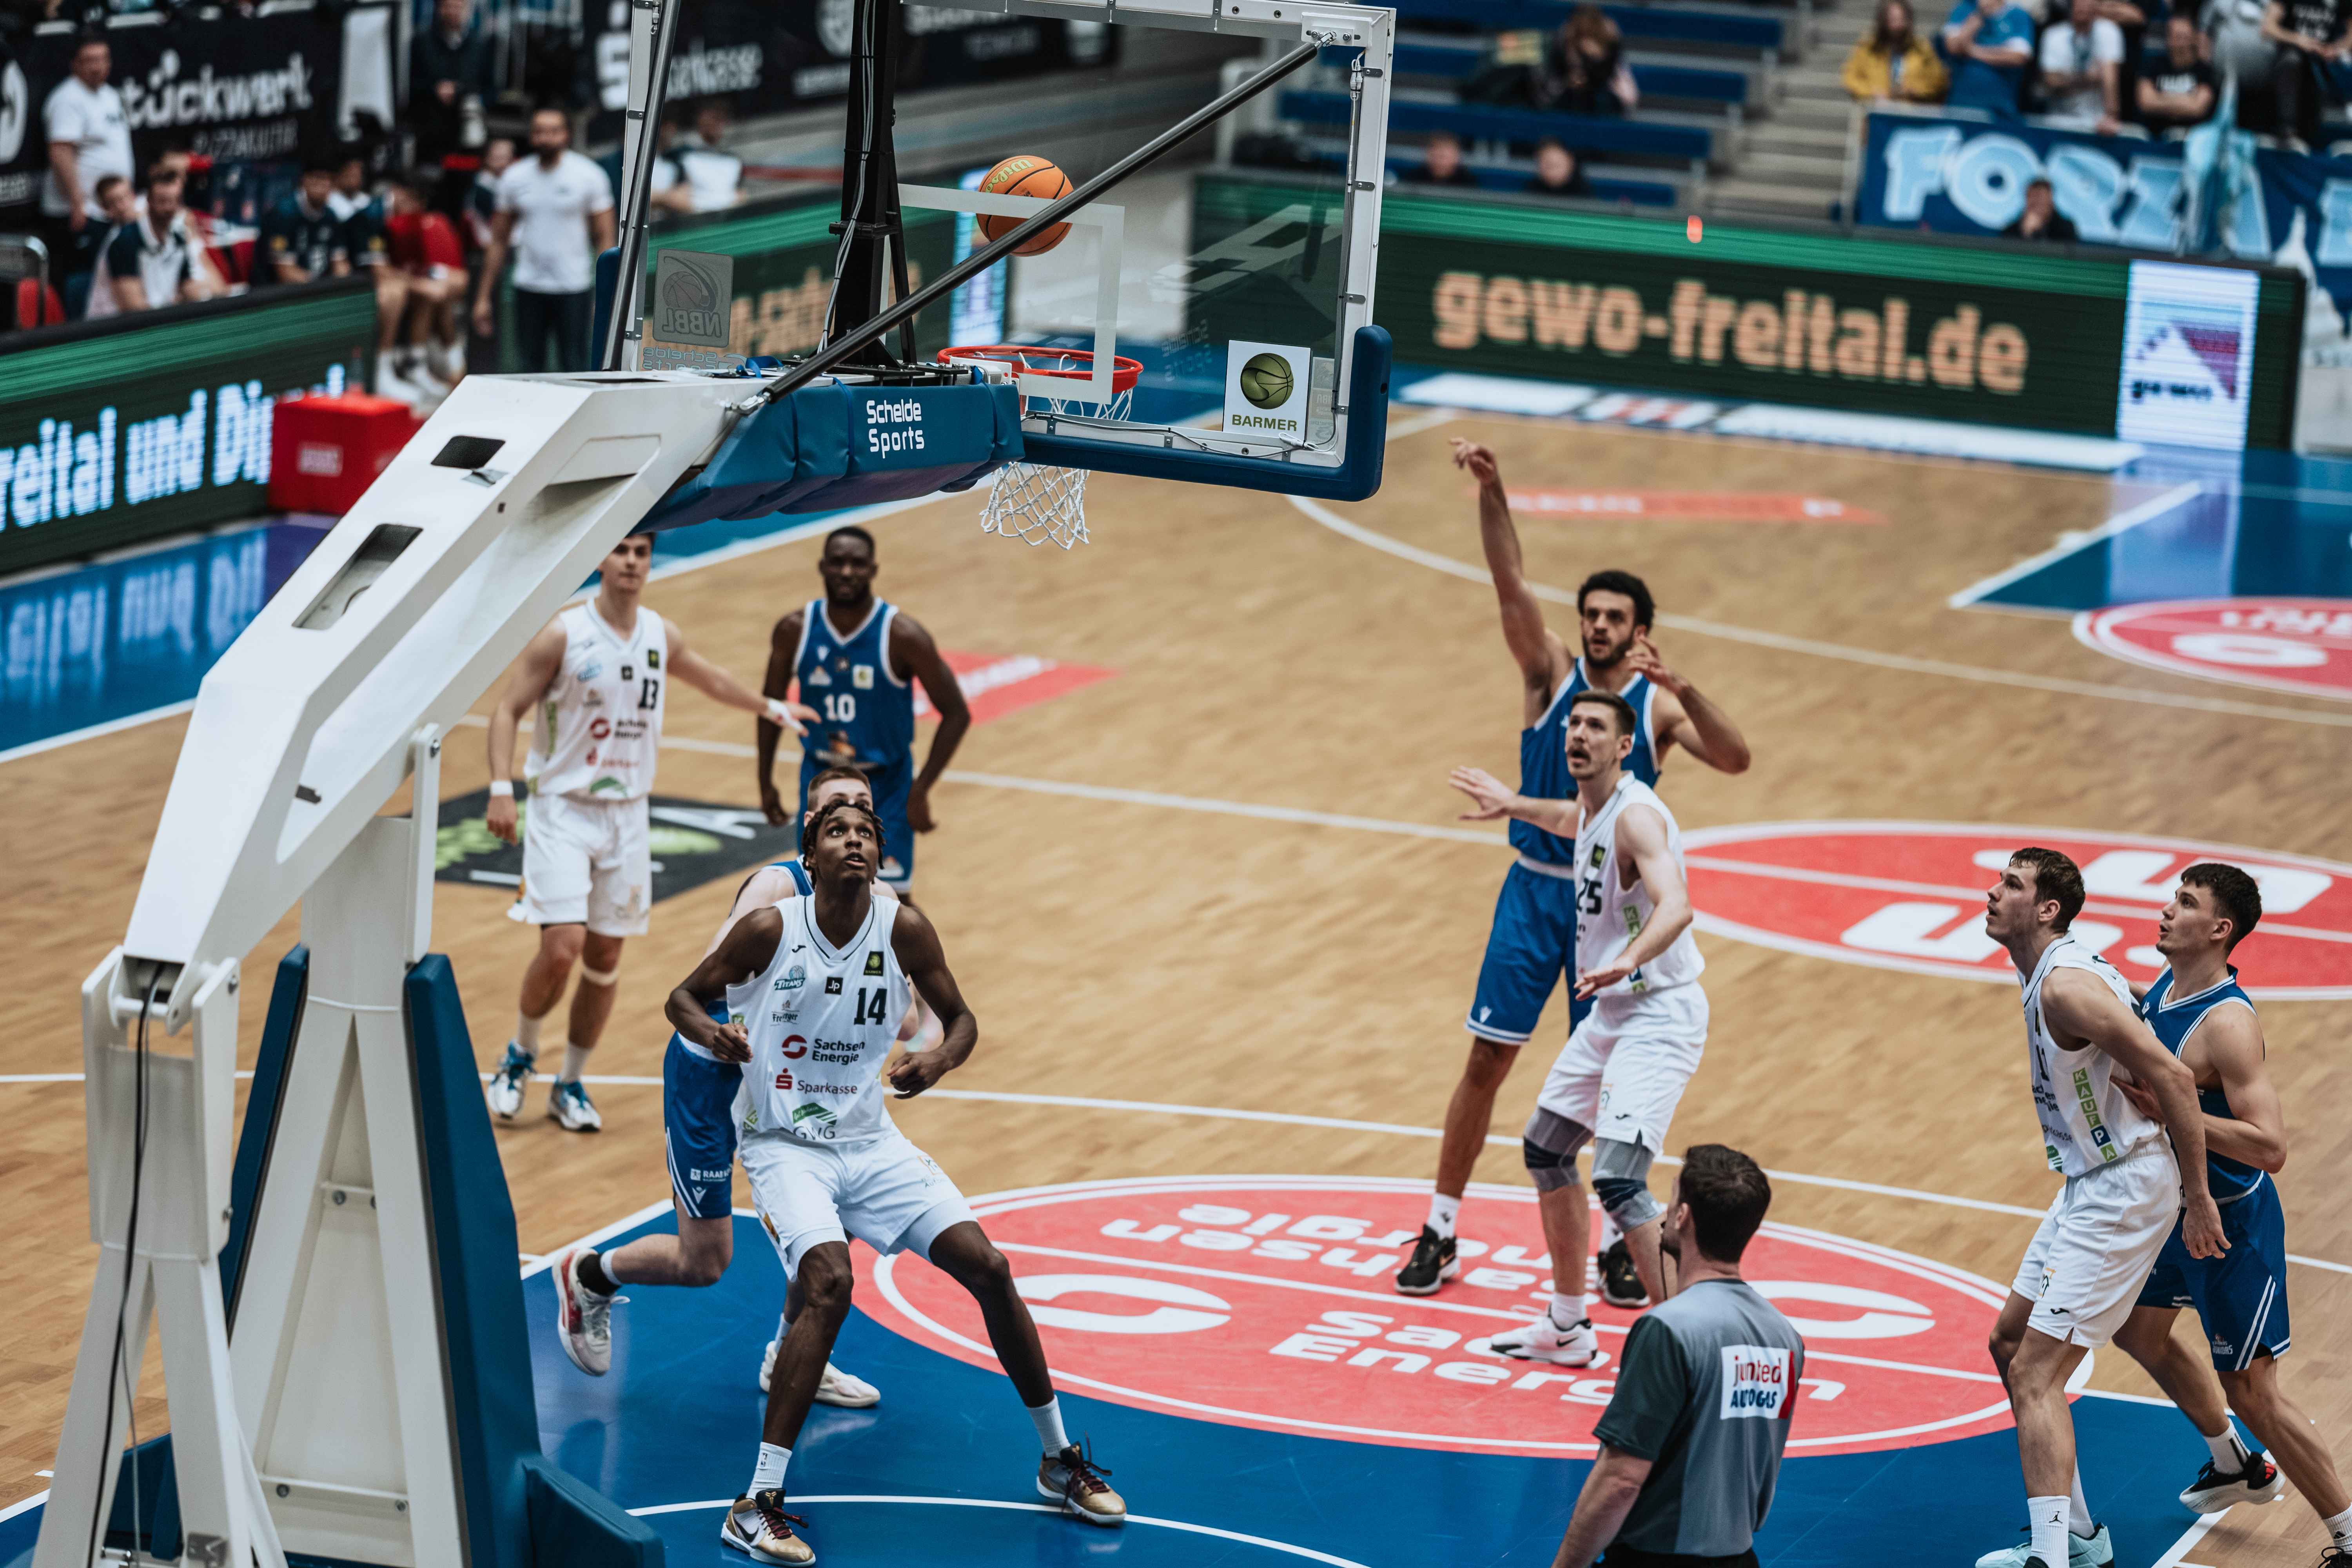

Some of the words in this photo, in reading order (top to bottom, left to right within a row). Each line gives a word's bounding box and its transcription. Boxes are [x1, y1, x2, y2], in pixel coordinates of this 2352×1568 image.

[122, 49, 314, 130] tückwerk
[985, 159, 1035, 193] Wilso
[1432, 270, 2030, 393] gewo-freital.de
[866, 398, 922, 424] Schelde
[1232, 414, 1297, 431] BARMER
[125, 388, 207, 505] und
[869, 426, 924, 459] Sports
[638, 678, 659, 710] 13
[824, 693, 856, 722] 10
[1576, 876, 1602, 915] 25
[854, 987, 887, 1025] 14
[812, 1050, 859, 1065] Energie
[813, 1038, 865, 1052] Sachsen
[797, 1080, 858, 1094] Sparkasse
[793, 1126, 835, 1140] GWG
[1269, 1332, 1614, 1407] Energ
